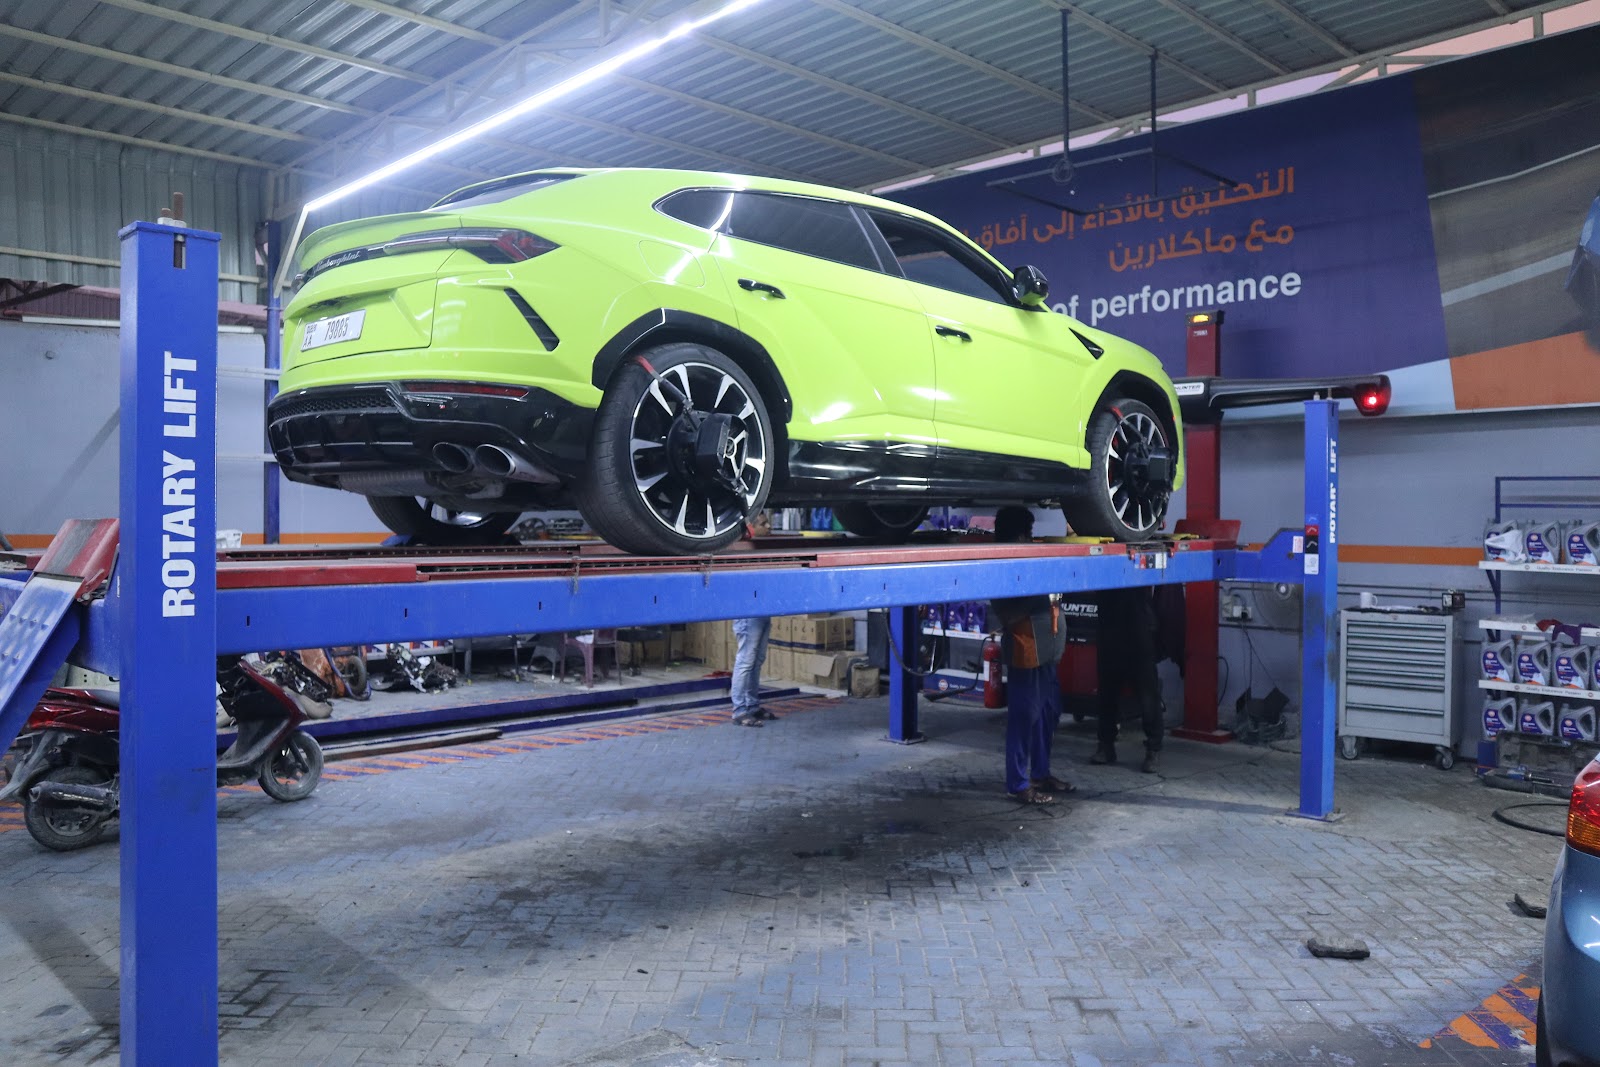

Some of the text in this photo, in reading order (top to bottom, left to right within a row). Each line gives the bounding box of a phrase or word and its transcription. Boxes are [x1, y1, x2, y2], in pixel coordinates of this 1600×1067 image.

[1033, 209, 1074, 242] إلى
[1082, 193, 1164, 230] بالأداء
[1109, 219, 1294, 272] مع ماكلارين
[1091, 272, 1301, 326] performance
[1330, 438, 1338, 474] LIFT
[161, 351, 197, 617] ROTARY LIFT
